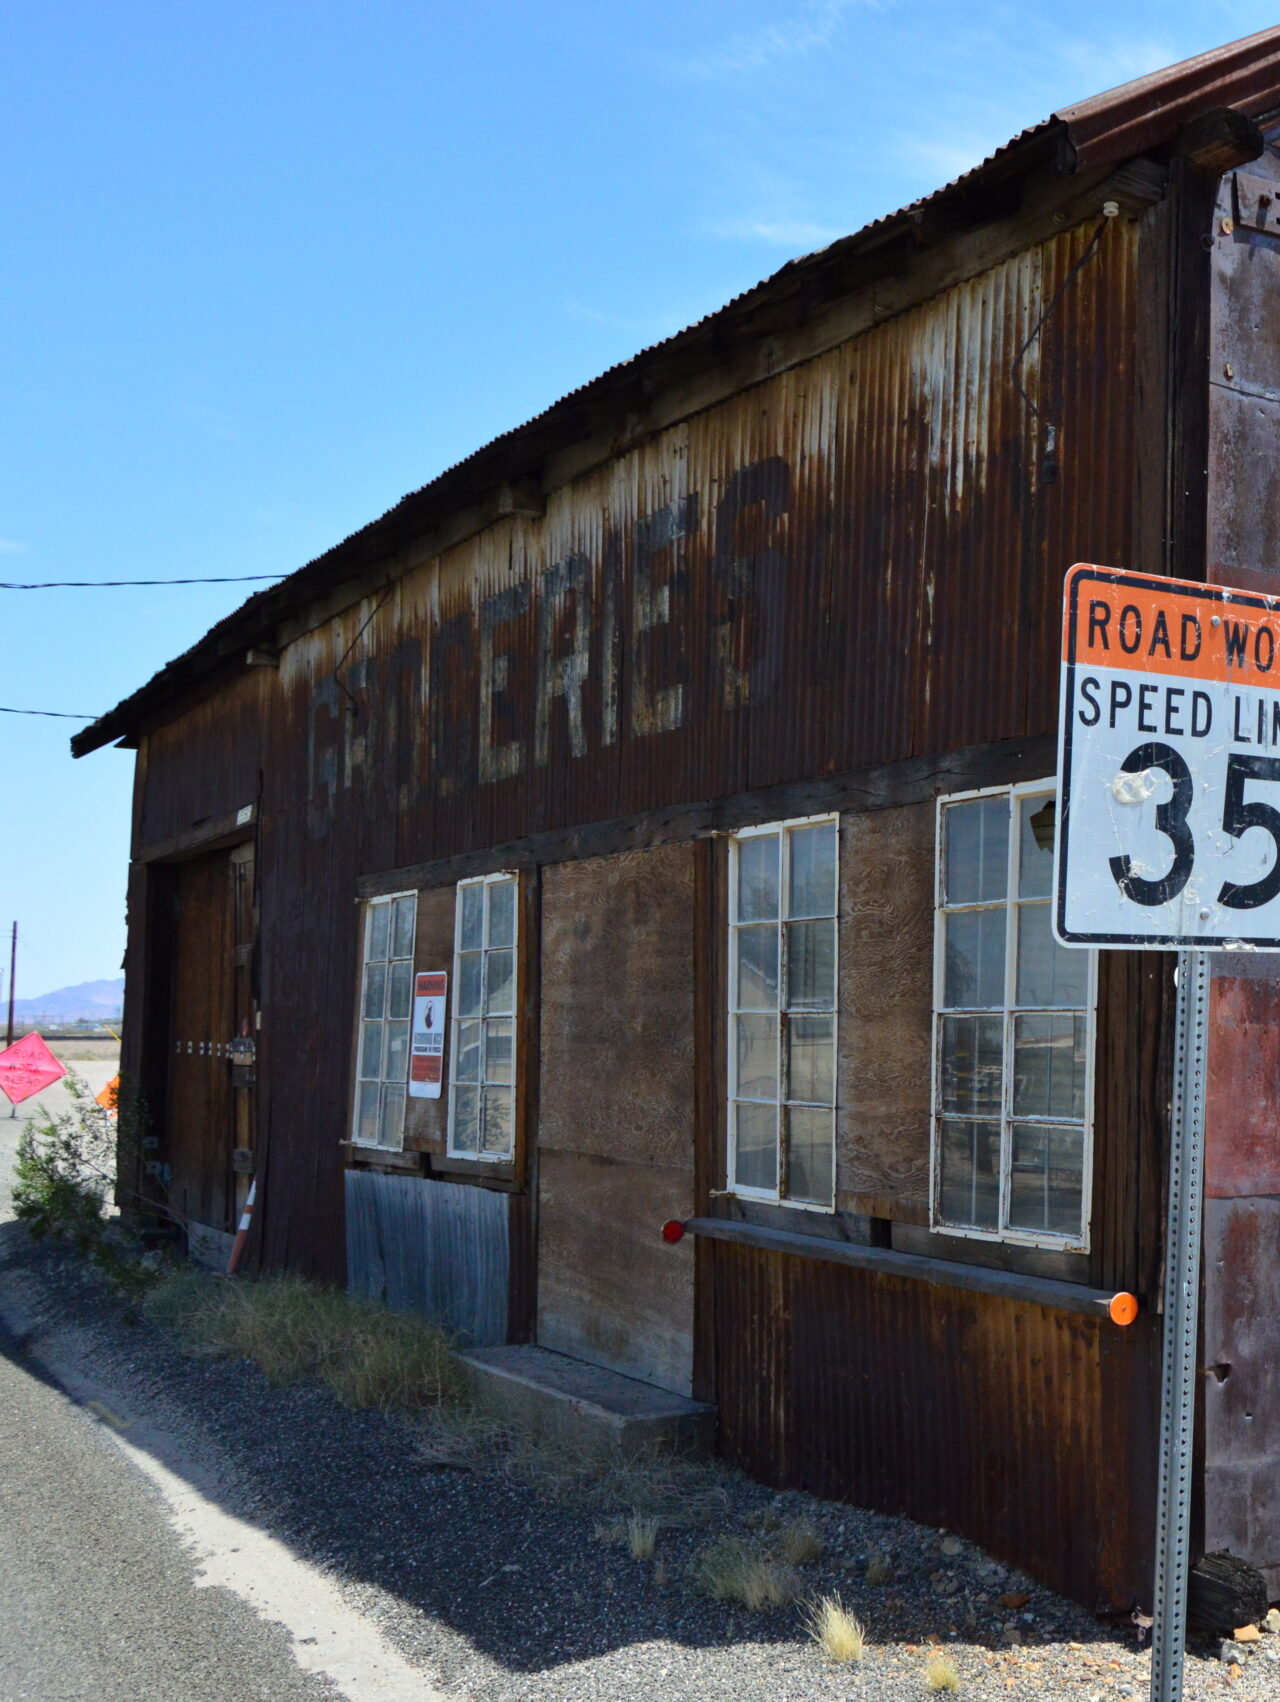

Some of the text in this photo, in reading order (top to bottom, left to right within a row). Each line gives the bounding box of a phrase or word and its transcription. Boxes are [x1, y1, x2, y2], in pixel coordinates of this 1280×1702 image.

[1087, 601, 1201, 661] ROAD
[1078, 676, 1212, 738] SPEED
[13, 1048, 45, 1060] ROAD
